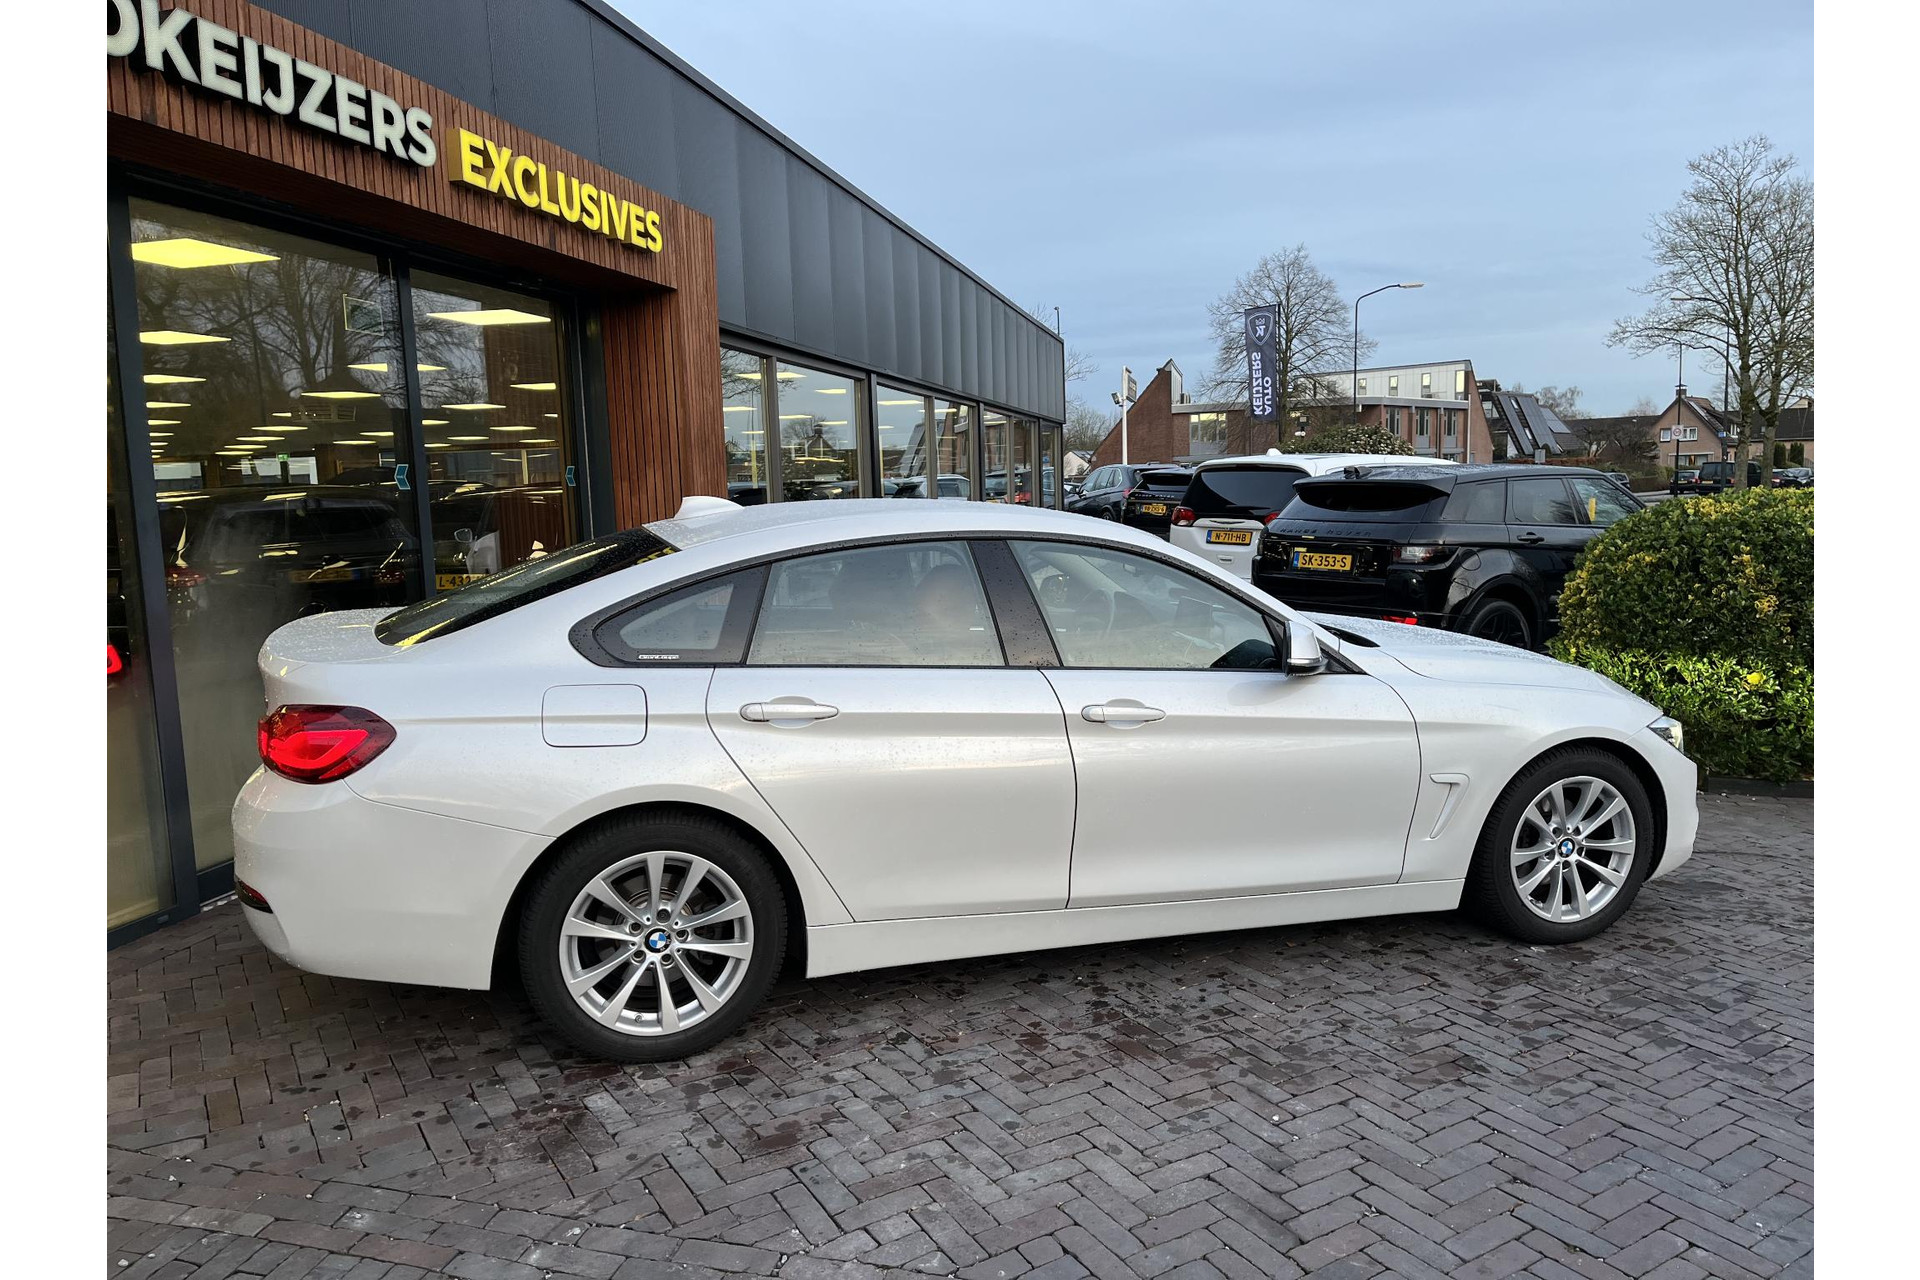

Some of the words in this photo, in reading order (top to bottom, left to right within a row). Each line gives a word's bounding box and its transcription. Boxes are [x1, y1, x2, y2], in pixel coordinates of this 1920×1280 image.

[459, 127, 663, 253] EXCLUSIVES
[1215, 532, 1247, 542] N-711-HB
[1301, 554, 1347, 568] SK-353-S
